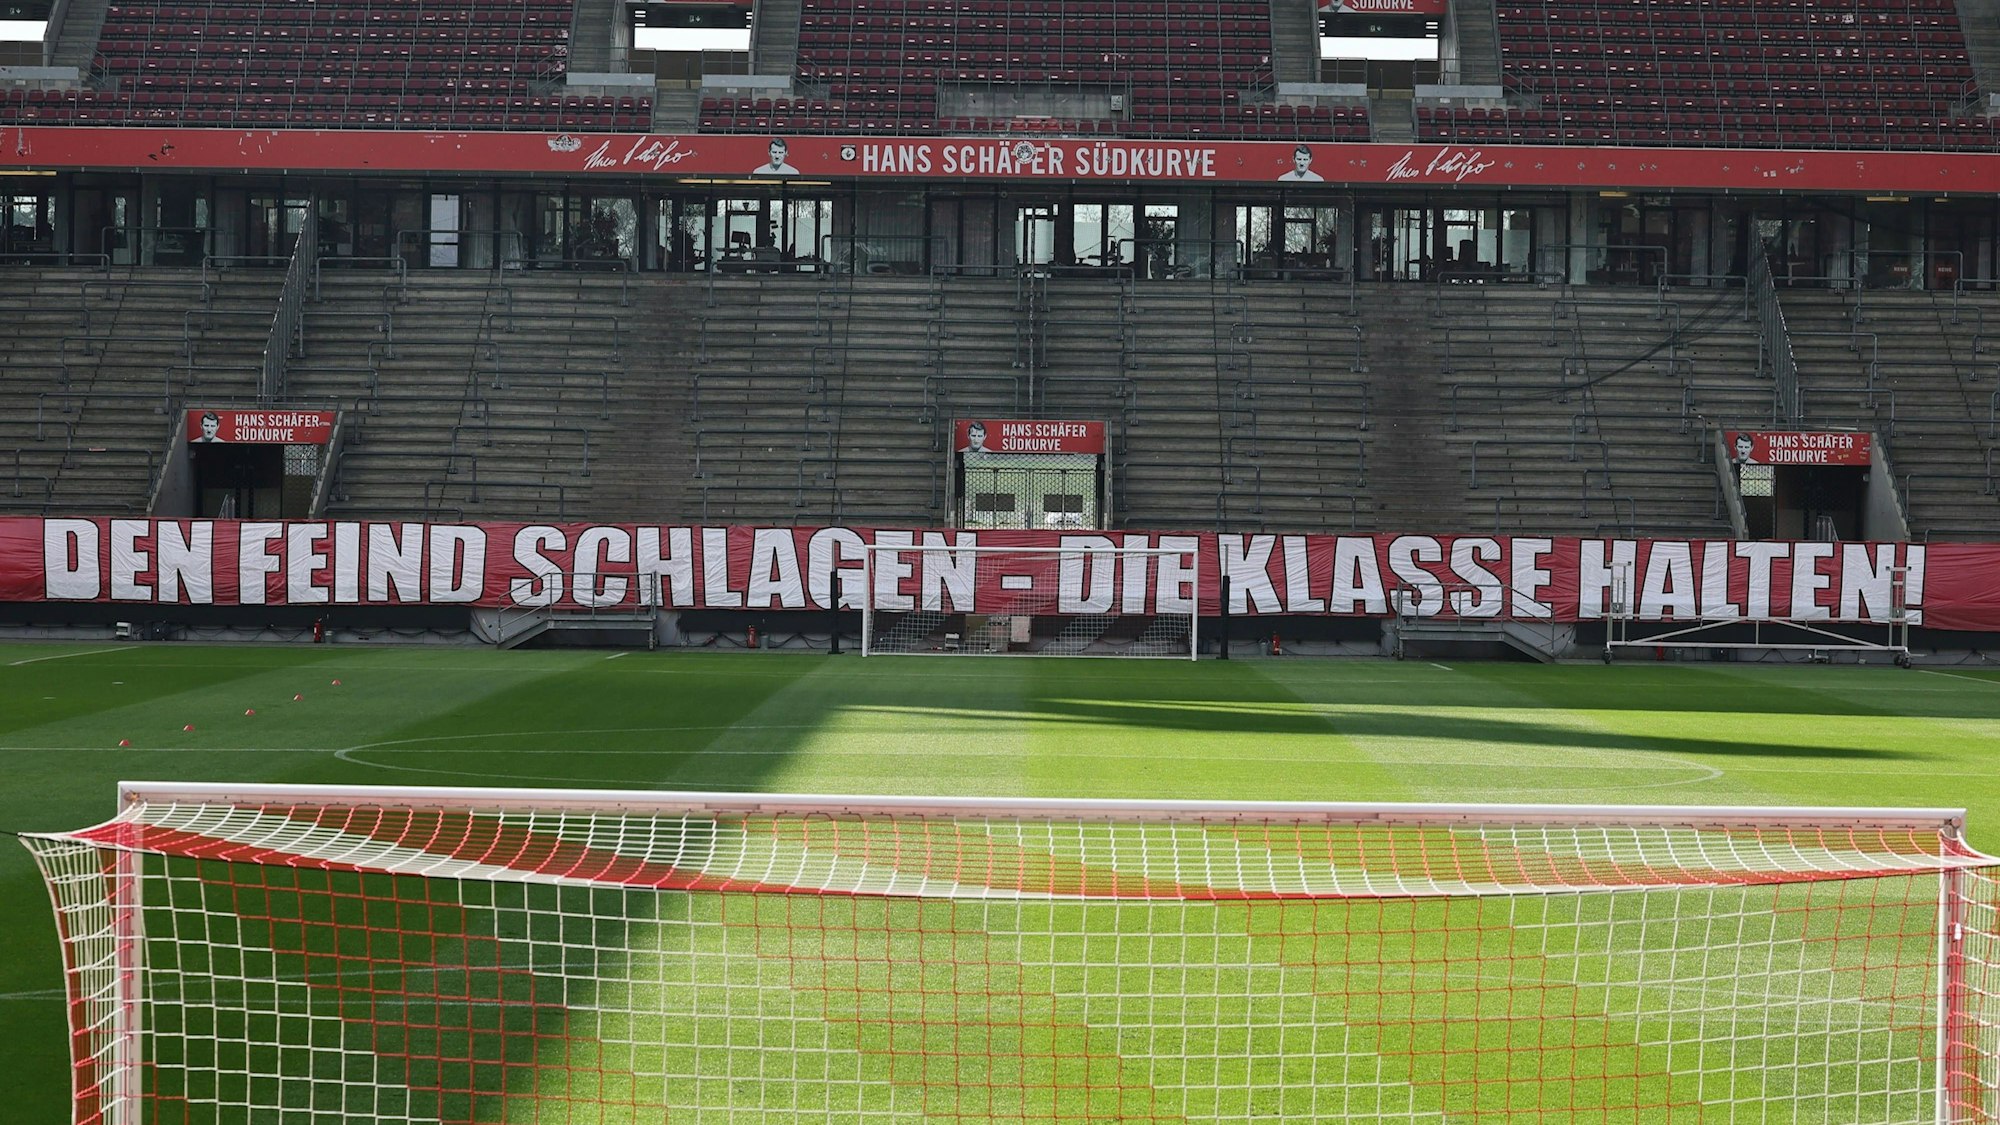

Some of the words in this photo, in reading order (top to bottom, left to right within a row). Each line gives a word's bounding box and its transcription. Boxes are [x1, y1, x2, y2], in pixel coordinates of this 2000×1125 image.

[862, 145, 932, 173] HANS
[1075, 142, 1216, 176] SÜDKURVE
[235, 414, 264, 427] HANS
[268, 413, 320, 428] SCHÄFER
[235, 427, 294, 442] SÜDKURVE
[1002, 424, 1032, 437] HANS
[1035, 422, 1087, 438] SCHÄFER
[1002, 437, 1062, 451] SÜDKURVE
[1769, 435, 1799, 448] HANS
[1802, 434, 1854, 449] SCHÄFER
[1769, 448, 1828, 463] SÜDKURVE
[44, 518, 213, 605] DEN
[239, 520, 486, 605] FEIND
[510, 524, 977, 613] SCHLAGEN
[1058, 534, 1200, 614] DIE
[1217, 532, 1554, 618] KLASSE
[1578, 538, 1927, 626] HALTEN!
